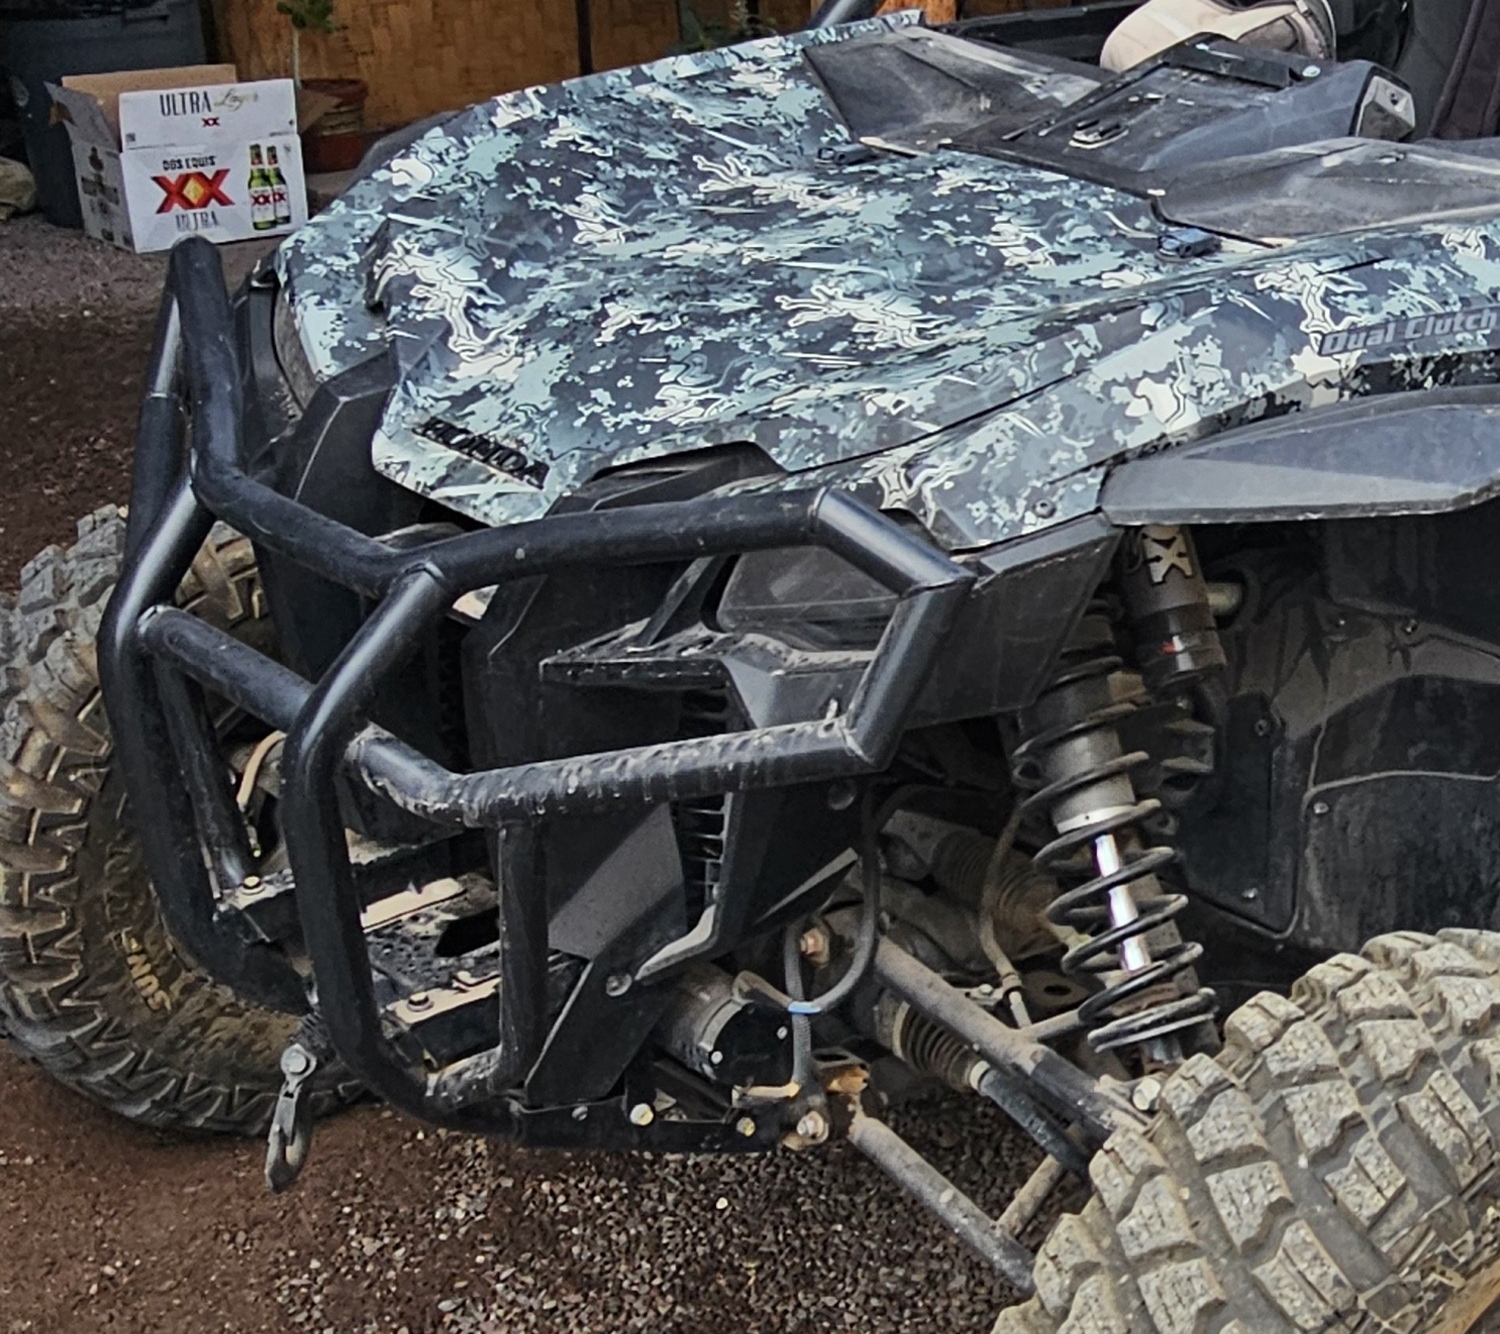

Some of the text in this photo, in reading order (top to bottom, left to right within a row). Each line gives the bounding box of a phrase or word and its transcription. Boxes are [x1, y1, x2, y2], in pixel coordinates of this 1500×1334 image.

[159, 91, 212, 117] ULTRA
[162, 155, 217, 171] DOS EQUIS
[151, 168, 236, 215] XX
[175, 210, 221, 233] ULTRA
[1321, 322, 1396, 355] Dual
[1404, 308, 1497, 339] Clutch
[412, 417, 550, 490] HONDA
